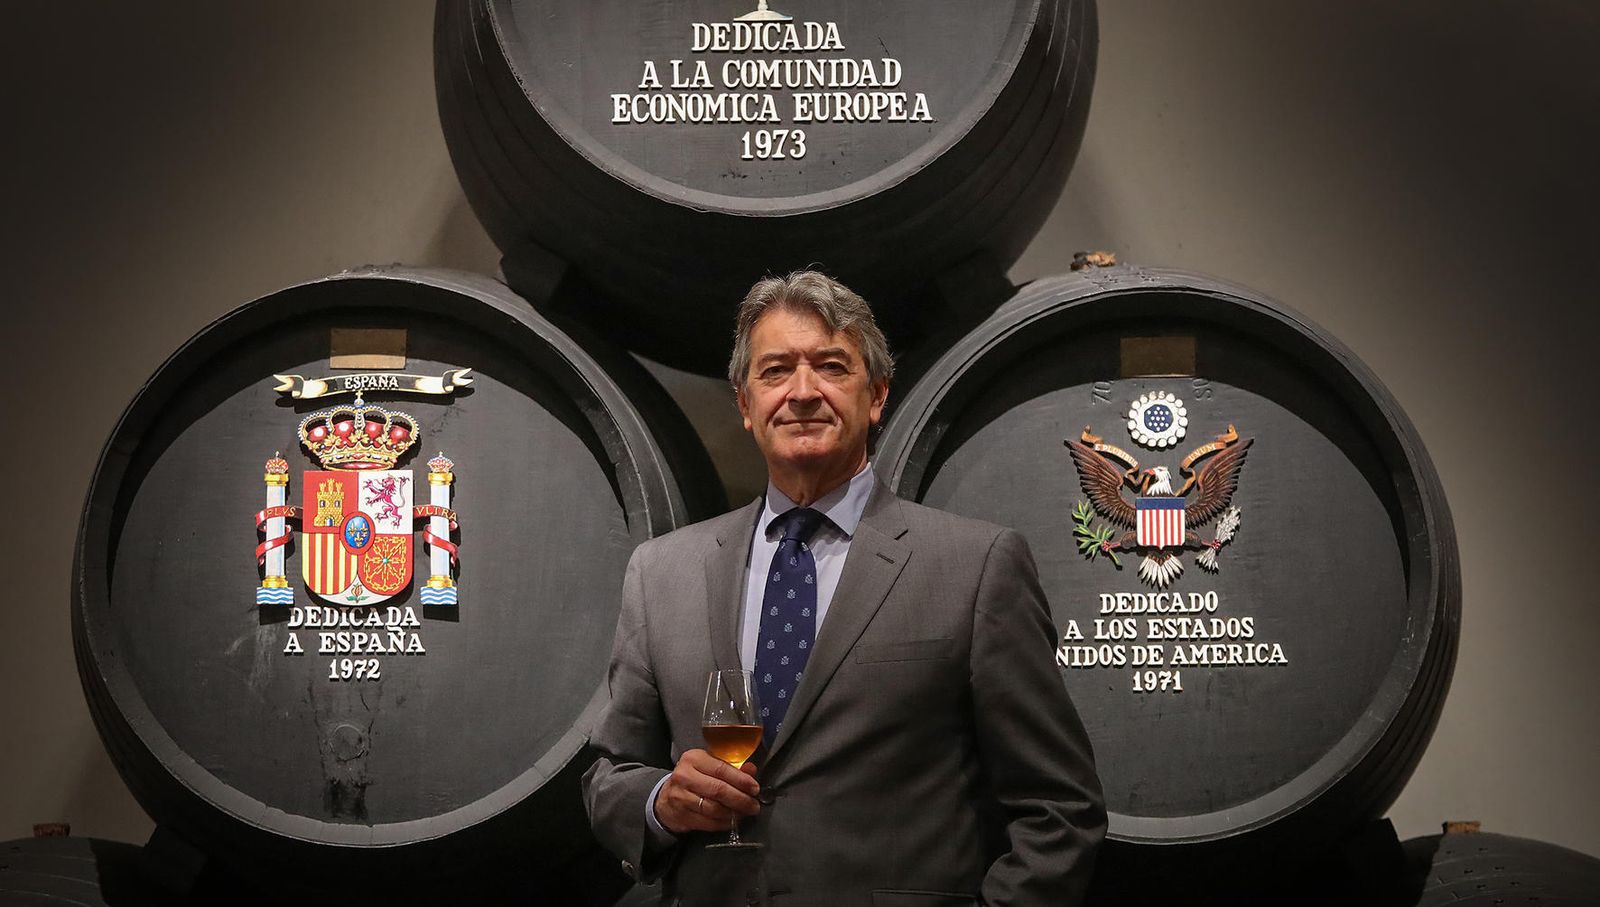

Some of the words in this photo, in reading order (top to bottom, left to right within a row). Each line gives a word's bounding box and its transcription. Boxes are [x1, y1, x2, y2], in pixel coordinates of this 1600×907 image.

[692, 22, 845, 51] DEDICADA
[638, 60, 663, 89] A
[670, 60, 714, 88] LA
[722, 58, 902, 88] COMUNIDAD
[611, 93, 781, 122] ECONOMICA
[792, 92, 932, 121] EUROPEA
[741, 129, 807, 159] 1973
[1100, 591, 1219, 614] DEDICADO
[288, 606, 421, 627] DEDICADA
[284, 633, 304, 653] A
[318, 626, 426, 653] ESPAÑA
[1064, 620, 1084, 640] A
[1094, 618, 1137, 640] LOS
[1147, 617, 1255, 640] ESTADOS
[1055, 644, 1127, 666] NIDOS
[1131, 645, 1164, 666] DE
[1170, 643, 1288, 666] AMERICA
[328, 658, 381, 679] 1972
[1132, 670, 1183, 691] 1971
